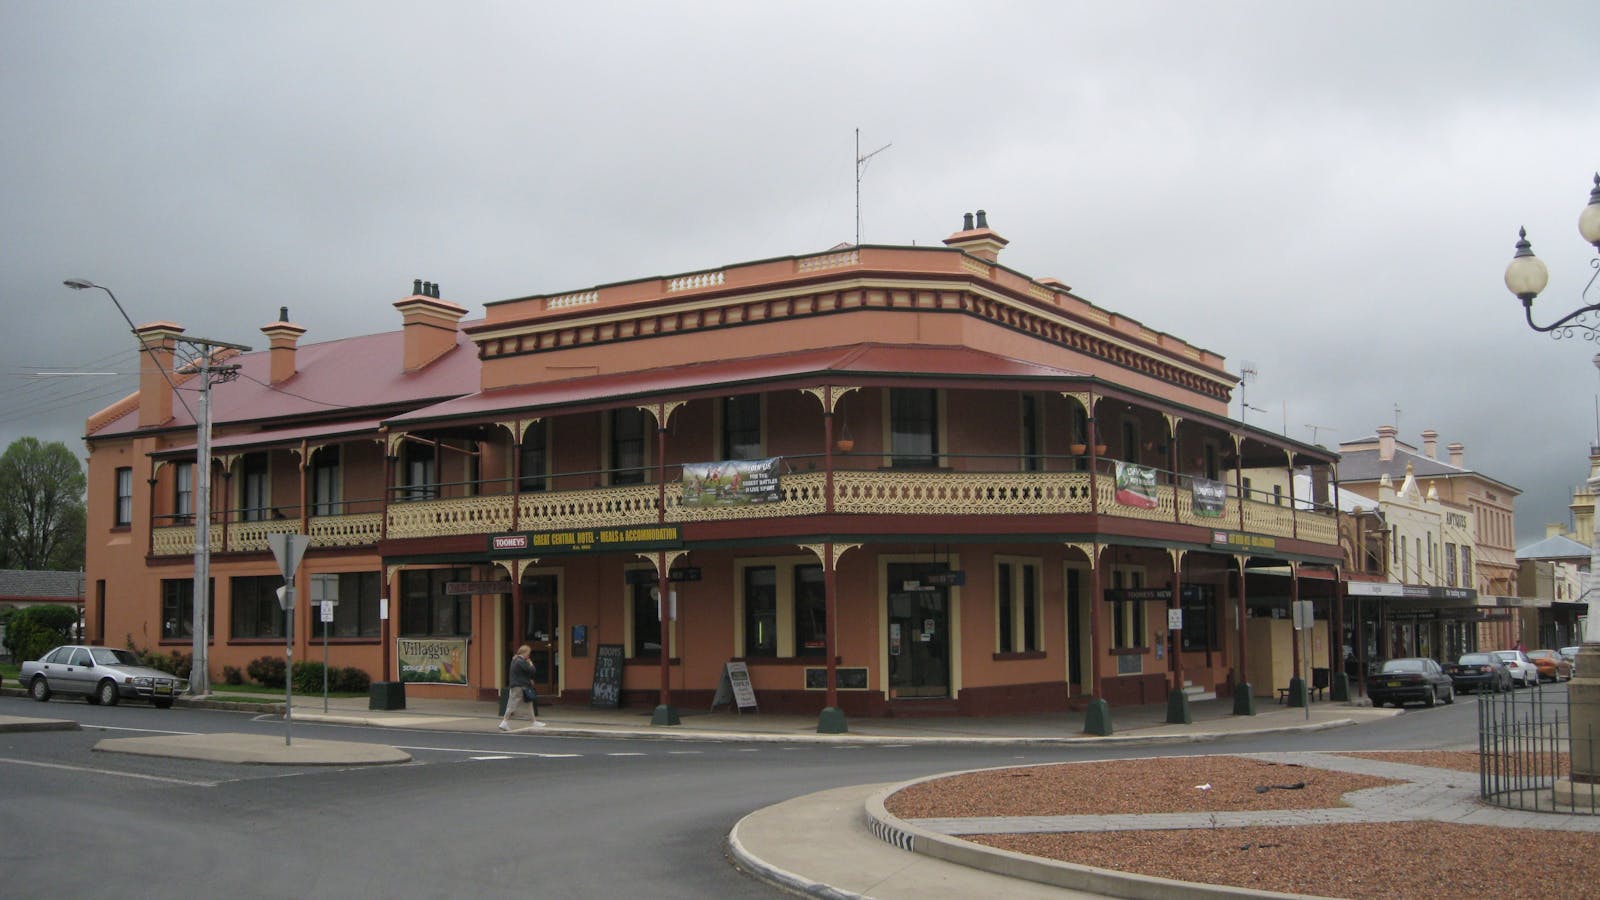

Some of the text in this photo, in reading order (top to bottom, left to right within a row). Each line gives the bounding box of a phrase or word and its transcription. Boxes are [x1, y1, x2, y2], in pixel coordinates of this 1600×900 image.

[1446, 511, 1467, 528] ANTIQUES
[495, 537, 525, 547] TOOHEYS
[534, 534, 550, 546] GREAT
[551, 532, 576, 545] CENTRAL
[577, 531, 594, 544] HOTEL
[600, 530, 619, 543] MEALS
[625, 528, 677, 542] ACCOMMODATION
[1156, 590, 1172, 598] NEW
[402, 641, 450, 659] Villaggio
[603, 657, 612, 667] TO
[600, 667, 615, 678] LET
